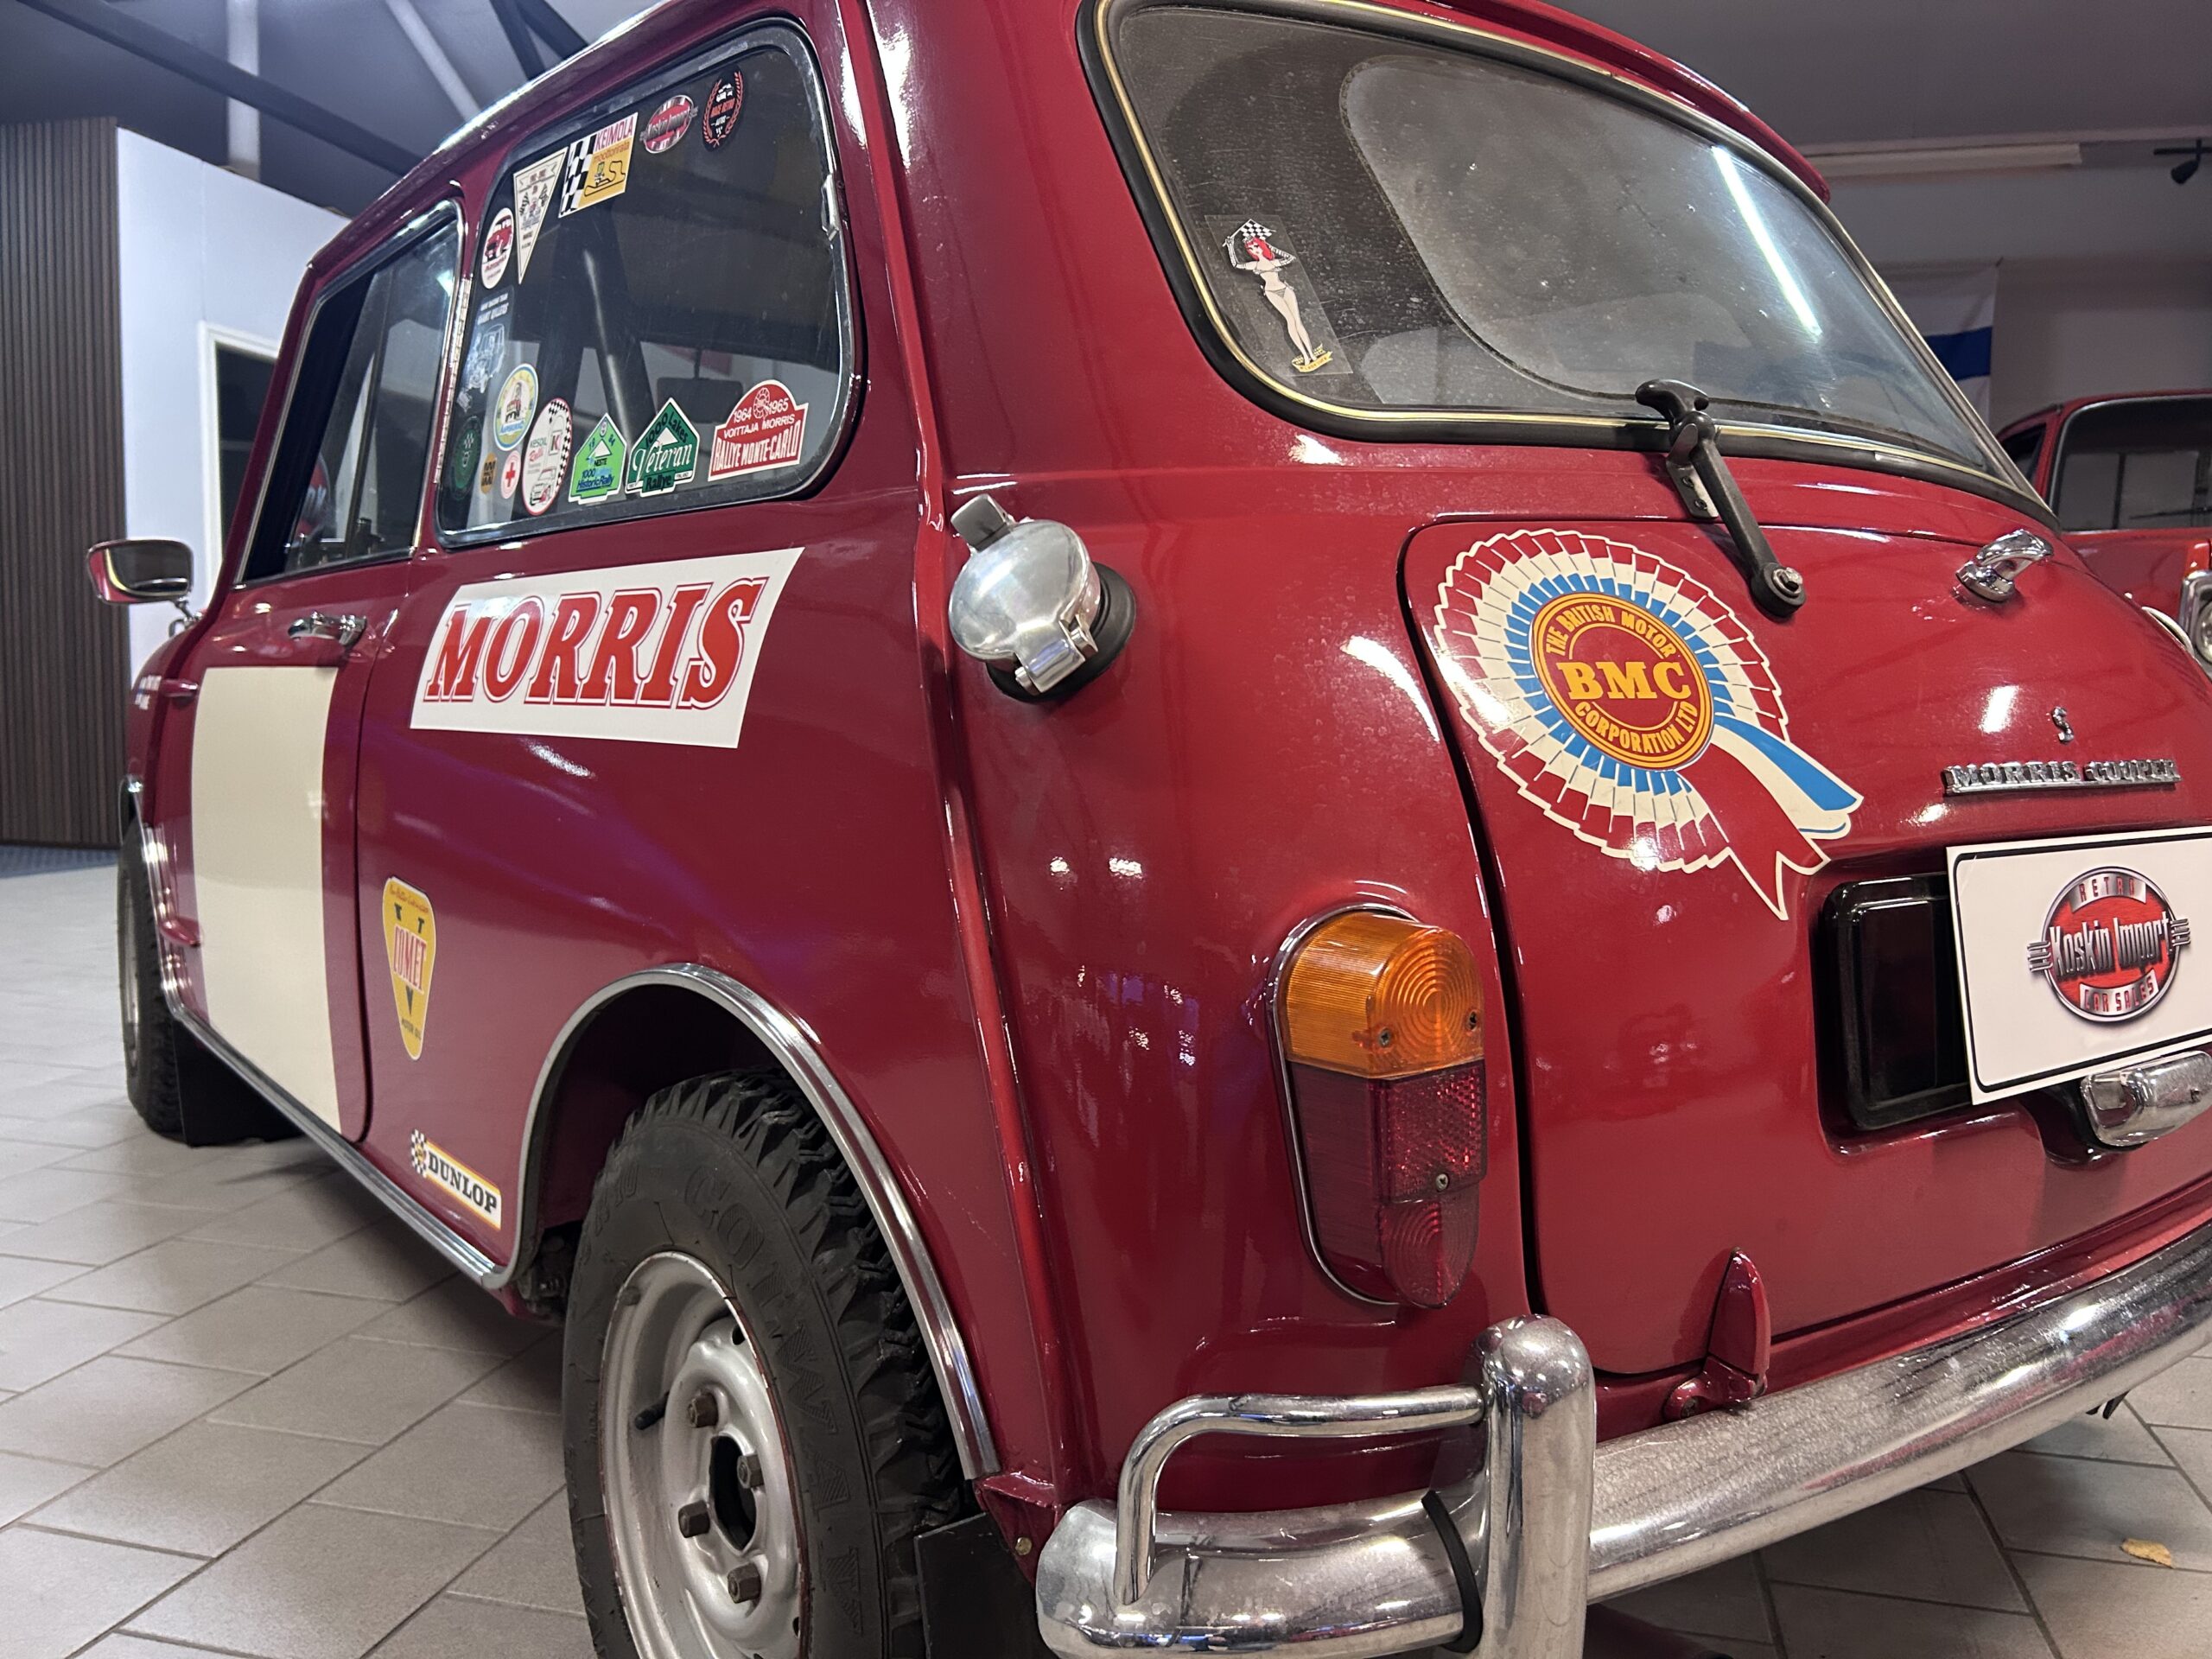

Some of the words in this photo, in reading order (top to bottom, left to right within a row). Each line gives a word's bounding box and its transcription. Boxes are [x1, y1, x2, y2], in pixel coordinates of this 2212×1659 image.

[594, 116, 634, 152] KEIMOLA
[723, 423, 759, 439] VOITTAJA
[761, 414, 795, 430] MORRIS
[734, 407, 752, 423] 1964
[768, 397, 789, 416] 1965
[645, 412, 669, 448] 1000
[668, 411, 690, 443] Lakes
[713, 436, 741, 472] RALLYE
[741, 419, 801, 467] MONTE-CARLO
[582, 467, 596, 479] 1000
[632, 442, 693, 485] Veteran
[646, 474, 673, 492] Rallye
[1555, 604, 1616, 632] BRITISH
[1620, 609, 1676, 658] MOTOR
[423, 576, 771, 710] MORRIS
[1545, 625, 1570, 657] THE
[1555, 660, 1693, 701] BMC
[1574, 702, 1686, 753] CORPORATION
[1675, 699, 1699, 733] LTD
[2050, 706, 2074, 744] S
[1949, 760, 2081, 786] MORRIS
[2087, 759, 2181, 783] COOPER
[2078, 876, 2137, 903] RETRO
[393, 925, 427, 991] COMET
[2049, 919, 2109, 978] Koskin
[2113, 911, 2171, 974] Import
[2083, 986, 2110, 1014] CAR
[2114, 975, 2156, 1013] SALES
[428, 1151, 498, 1214] DUNLOP
